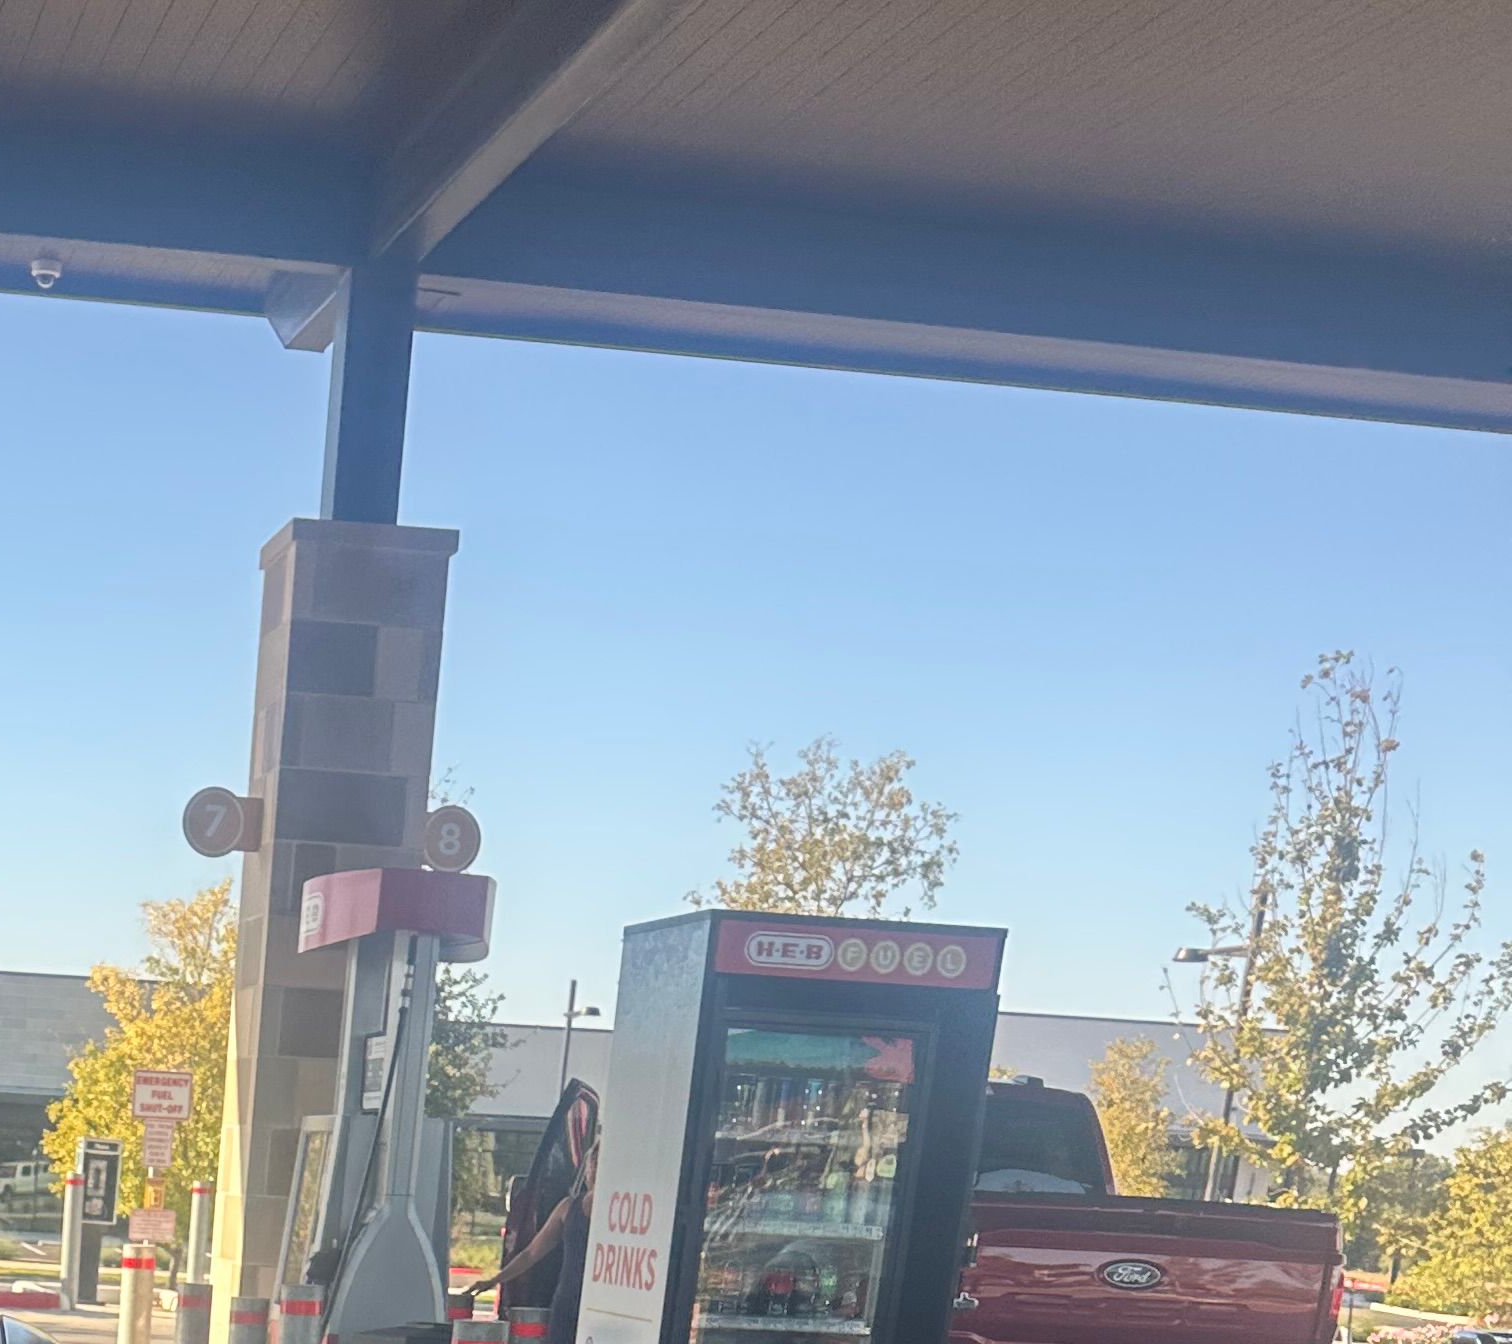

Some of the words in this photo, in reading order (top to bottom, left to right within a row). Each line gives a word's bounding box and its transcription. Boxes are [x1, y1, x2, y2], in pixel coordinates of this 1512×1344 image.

[204, 804, 227, 838] 7
[439, 822, 462, 856] 8
[844, 943, 960, 973] FUEL
[136, 1076, 190, 1088] EMERGENCY
[151, 1090, 174, 1101] FUEL
[139, 1102, 185, 1114] SHUT-OFF
[607, 1191, 654, 1236] COLD
[591, 1243, 658, 1292] DRINKS
[1112, 1264, 1152, 1284] Ford
